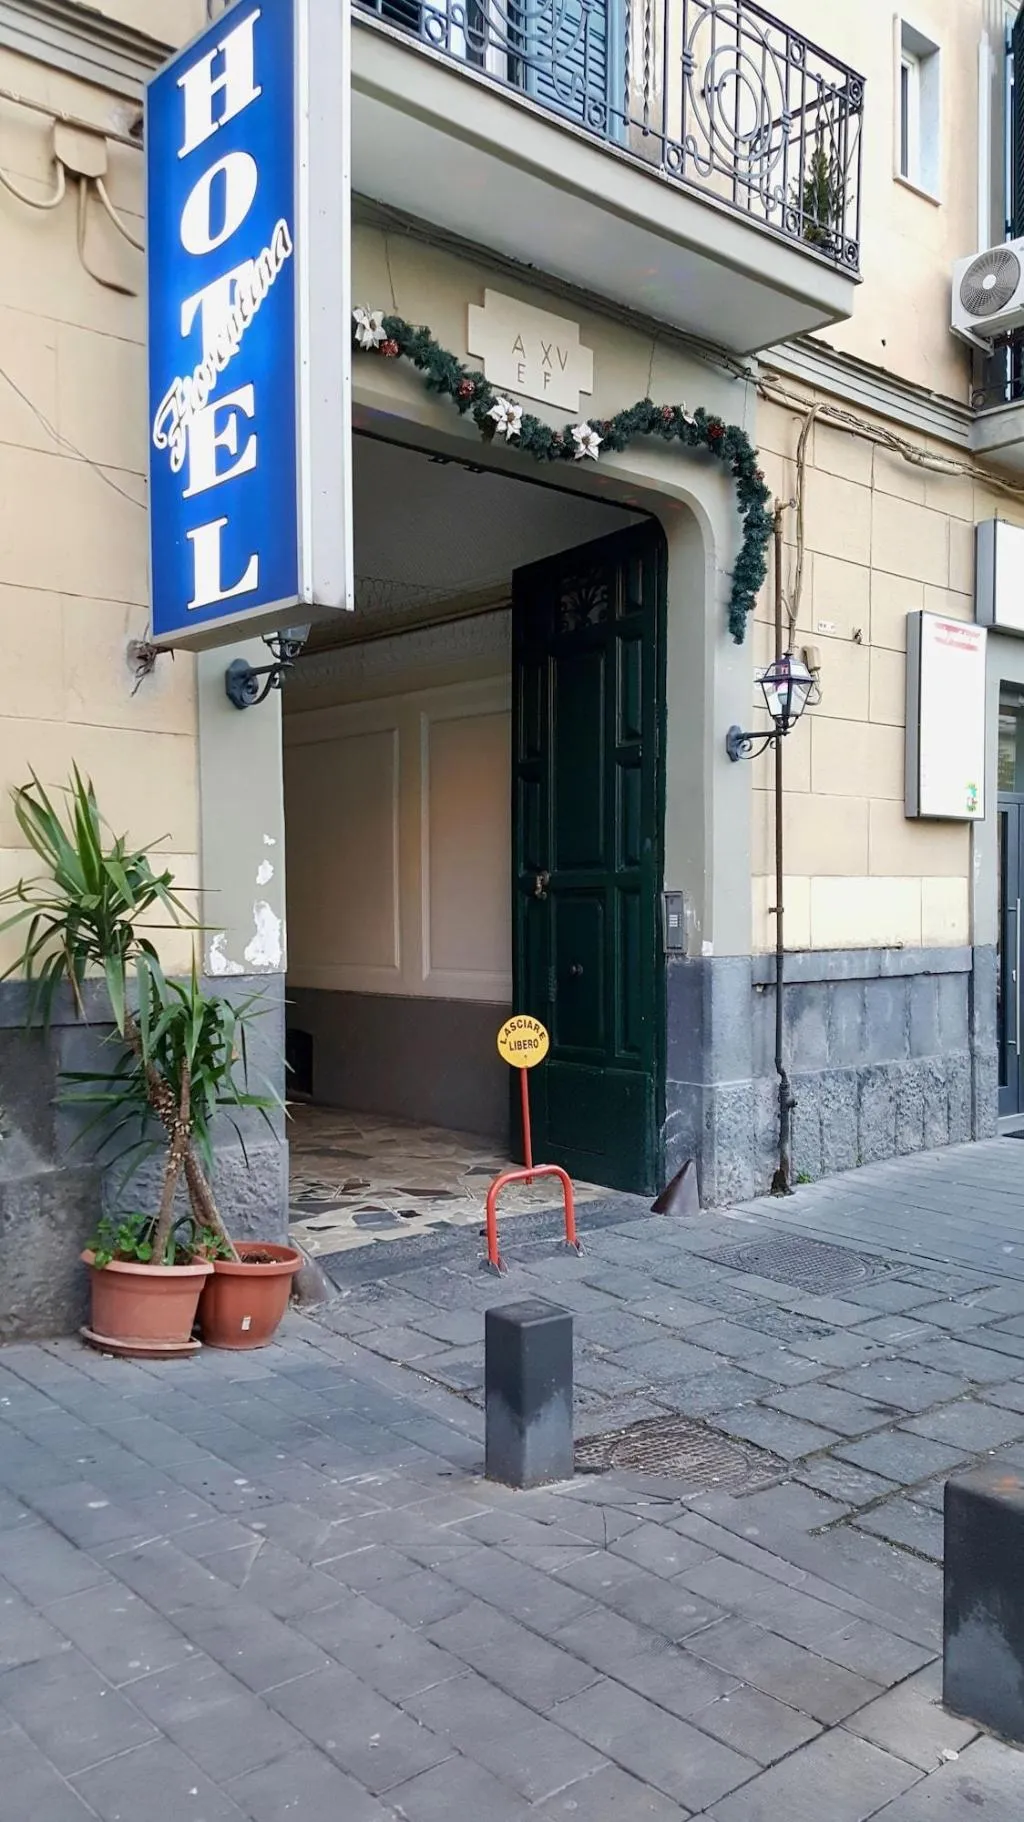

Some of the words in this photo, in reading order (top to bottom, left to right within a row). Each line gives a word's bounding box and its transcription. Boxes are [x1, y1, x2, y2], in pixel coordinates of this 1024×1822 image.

[176, 8, 262, 610] HOTEL
[511, 334, 526, 359] A
[540, 340, 569, 372] XV
[517, 362, 526, 384] E
[543, 371, 552, 390] F
[500, 1019, 546, 1045] LASCIARE
[508, 1038, 539, 1051] LIBERO
